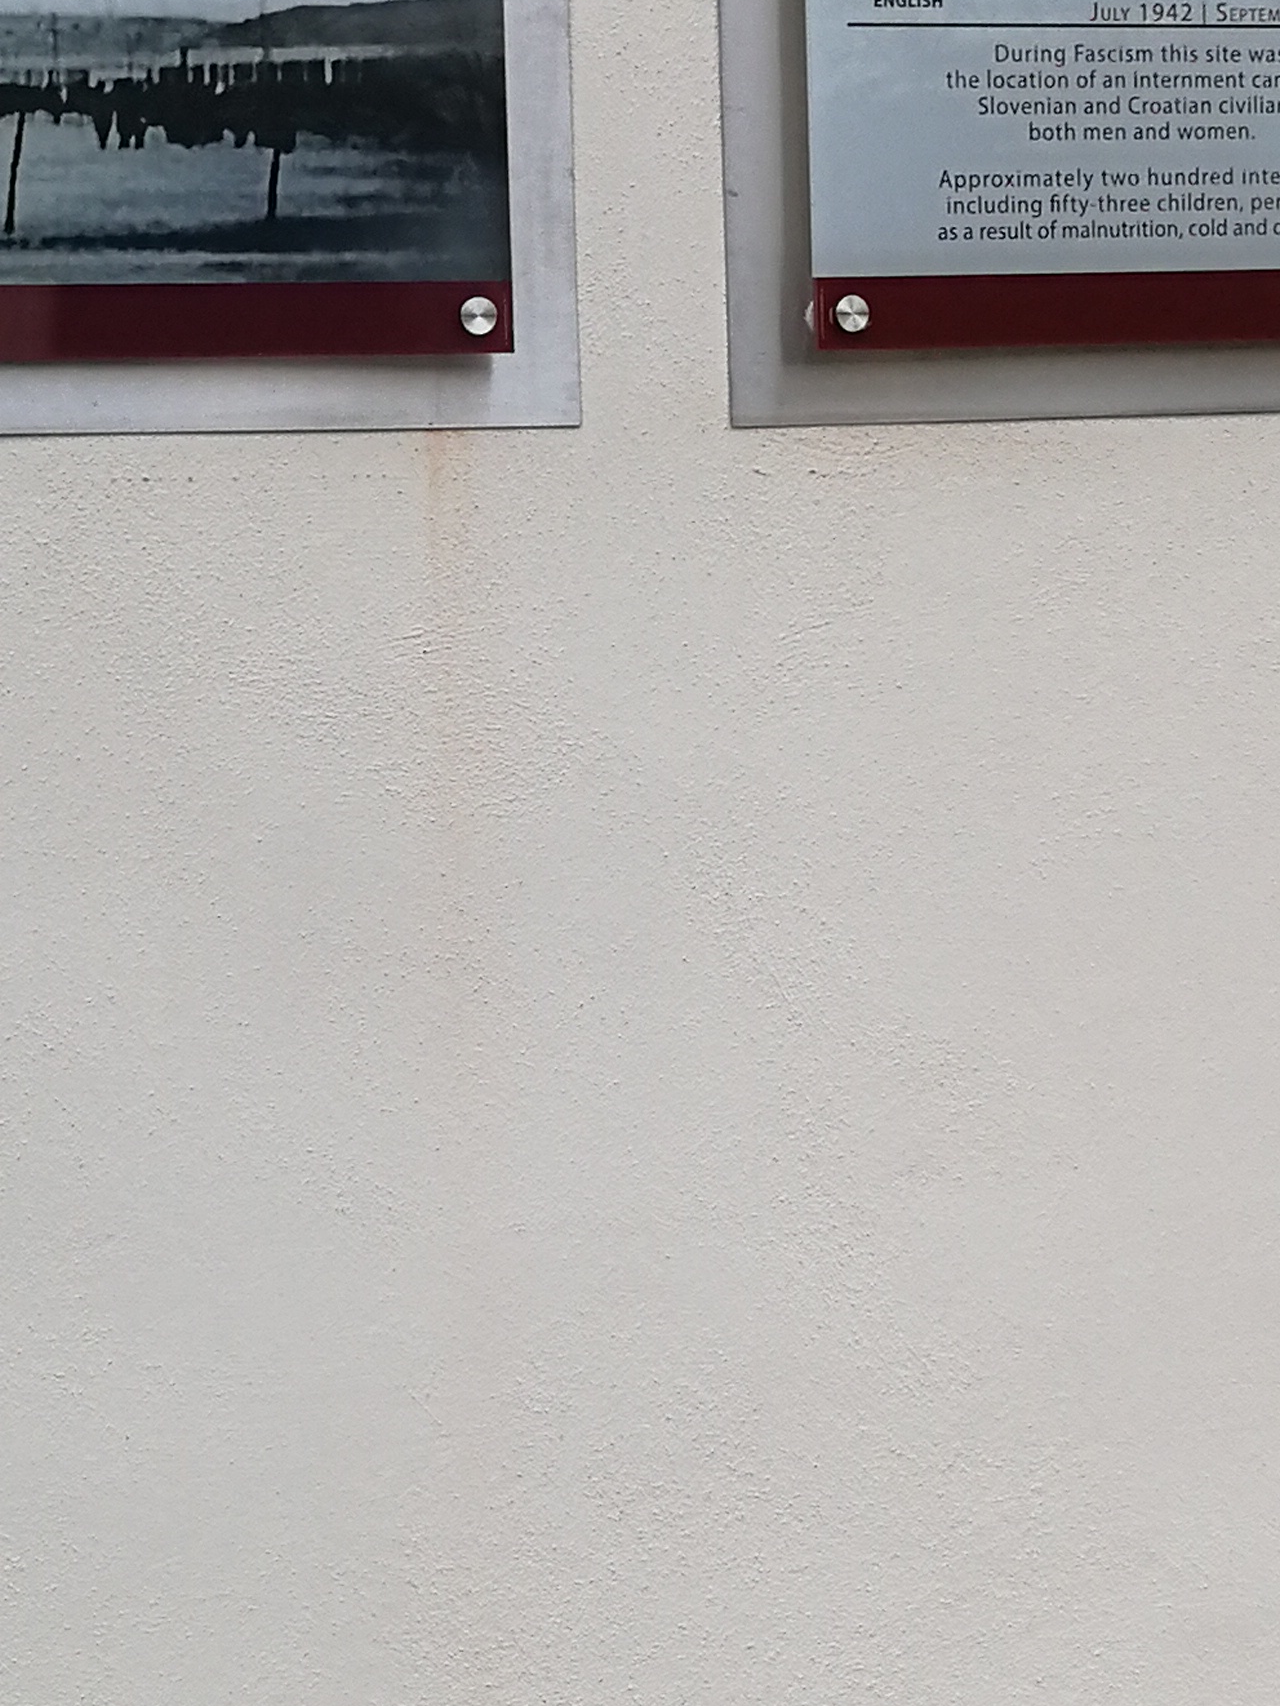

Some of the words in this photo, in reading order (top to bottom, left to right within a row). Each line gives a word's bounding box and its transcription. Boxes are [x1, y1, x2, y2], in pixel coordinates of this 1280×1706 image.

[1139, 2, 1193, 23] 1942
[994, 43, 1066, 68] During
[1074, 43, 1154, 63] Fascism
[1160, 43, 1199, 64] this
[1205, 45, 1242, 64] site
[946, 69, 980, 89] the
[986, 68, 1069, 89] location
[1076, 69, 1097, 89] of
[1102, 74, 1126, 89] an
[1133, 70, 1245, 89] internment
[978, 95, 1077, 116] Slovenian
[1083, 95, 1121, 115] and
[1127, 95, 1212, 115] Croatian
